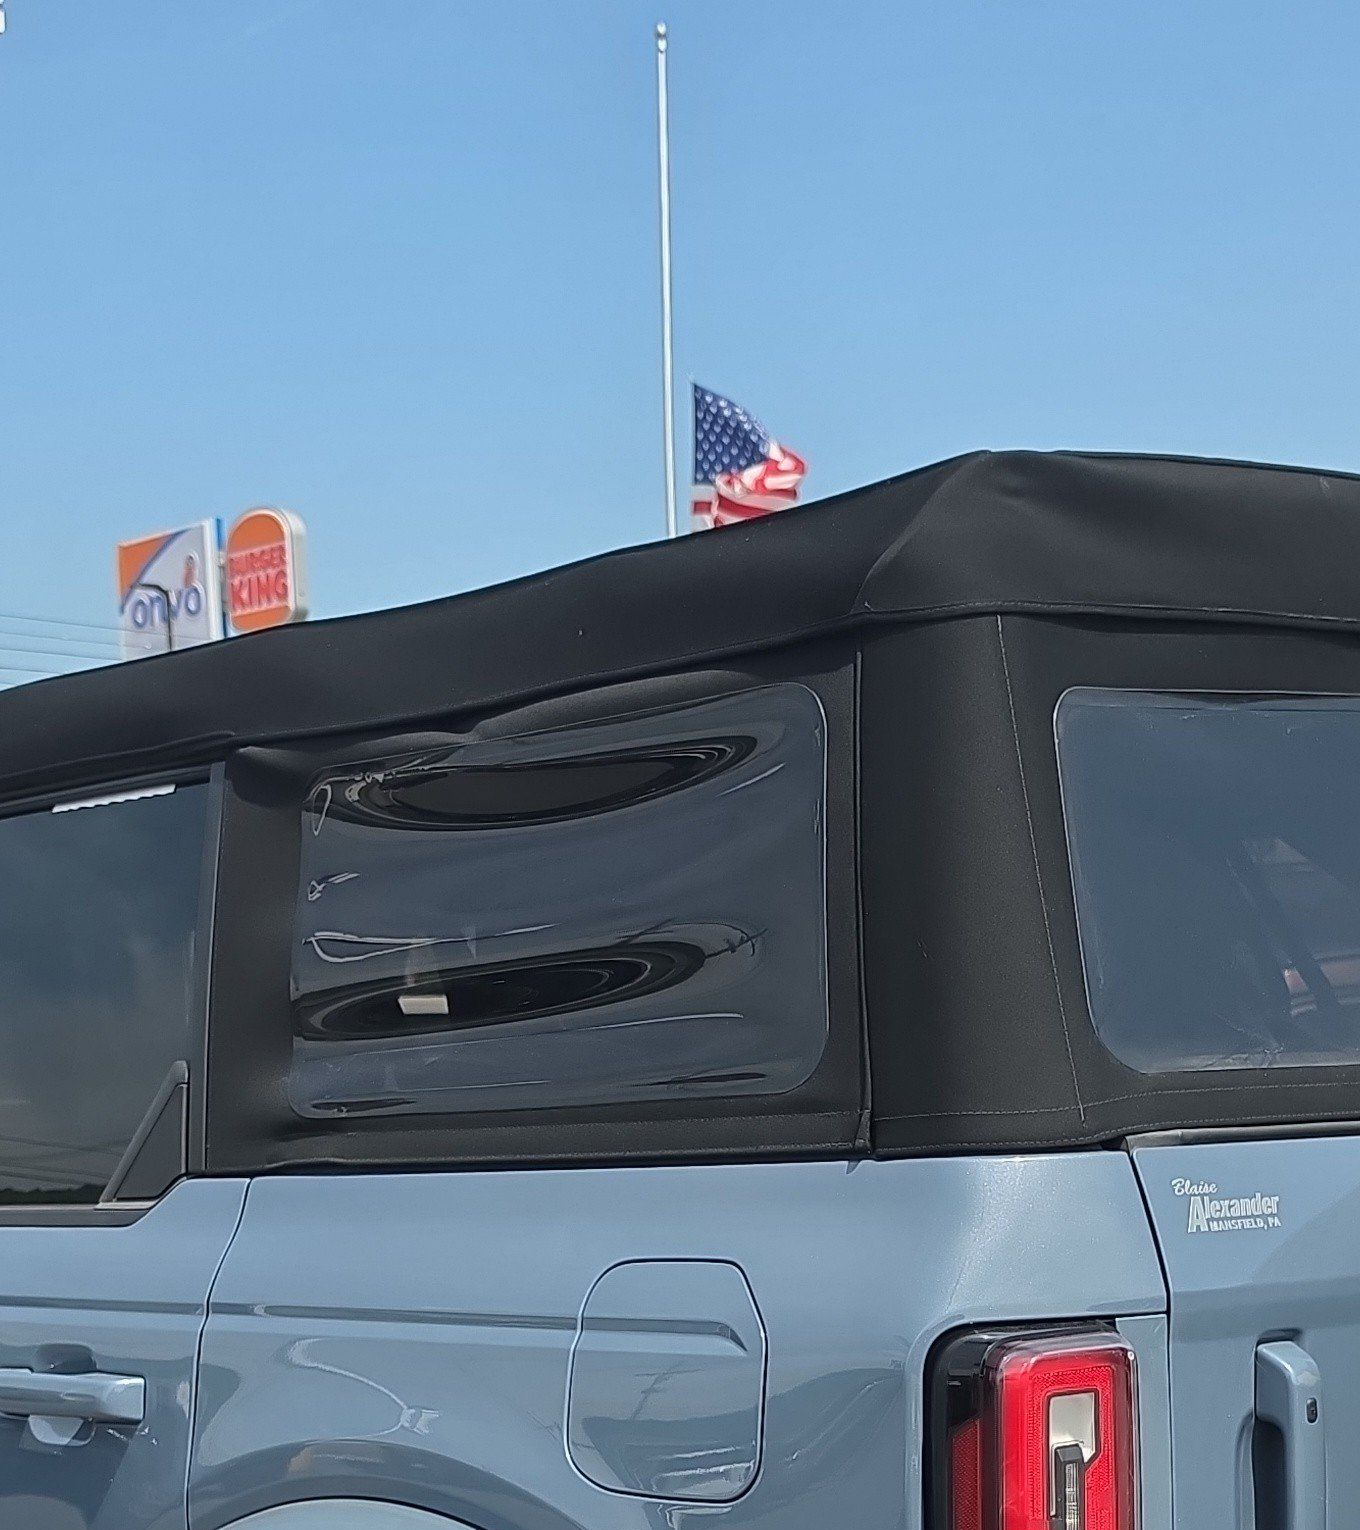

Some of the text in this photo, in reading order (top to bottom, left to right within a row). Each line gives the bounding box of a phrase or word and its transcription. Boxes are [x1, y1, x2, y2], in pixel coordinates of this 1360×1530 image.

[231, 570, 288, 614] KING
[1171, 1178, 1218, 1196] Blaise
[1188, 1193, 1280, 1233] Alexander
[1208, 1216, 1282, 1232] MANSFIELD, PA
